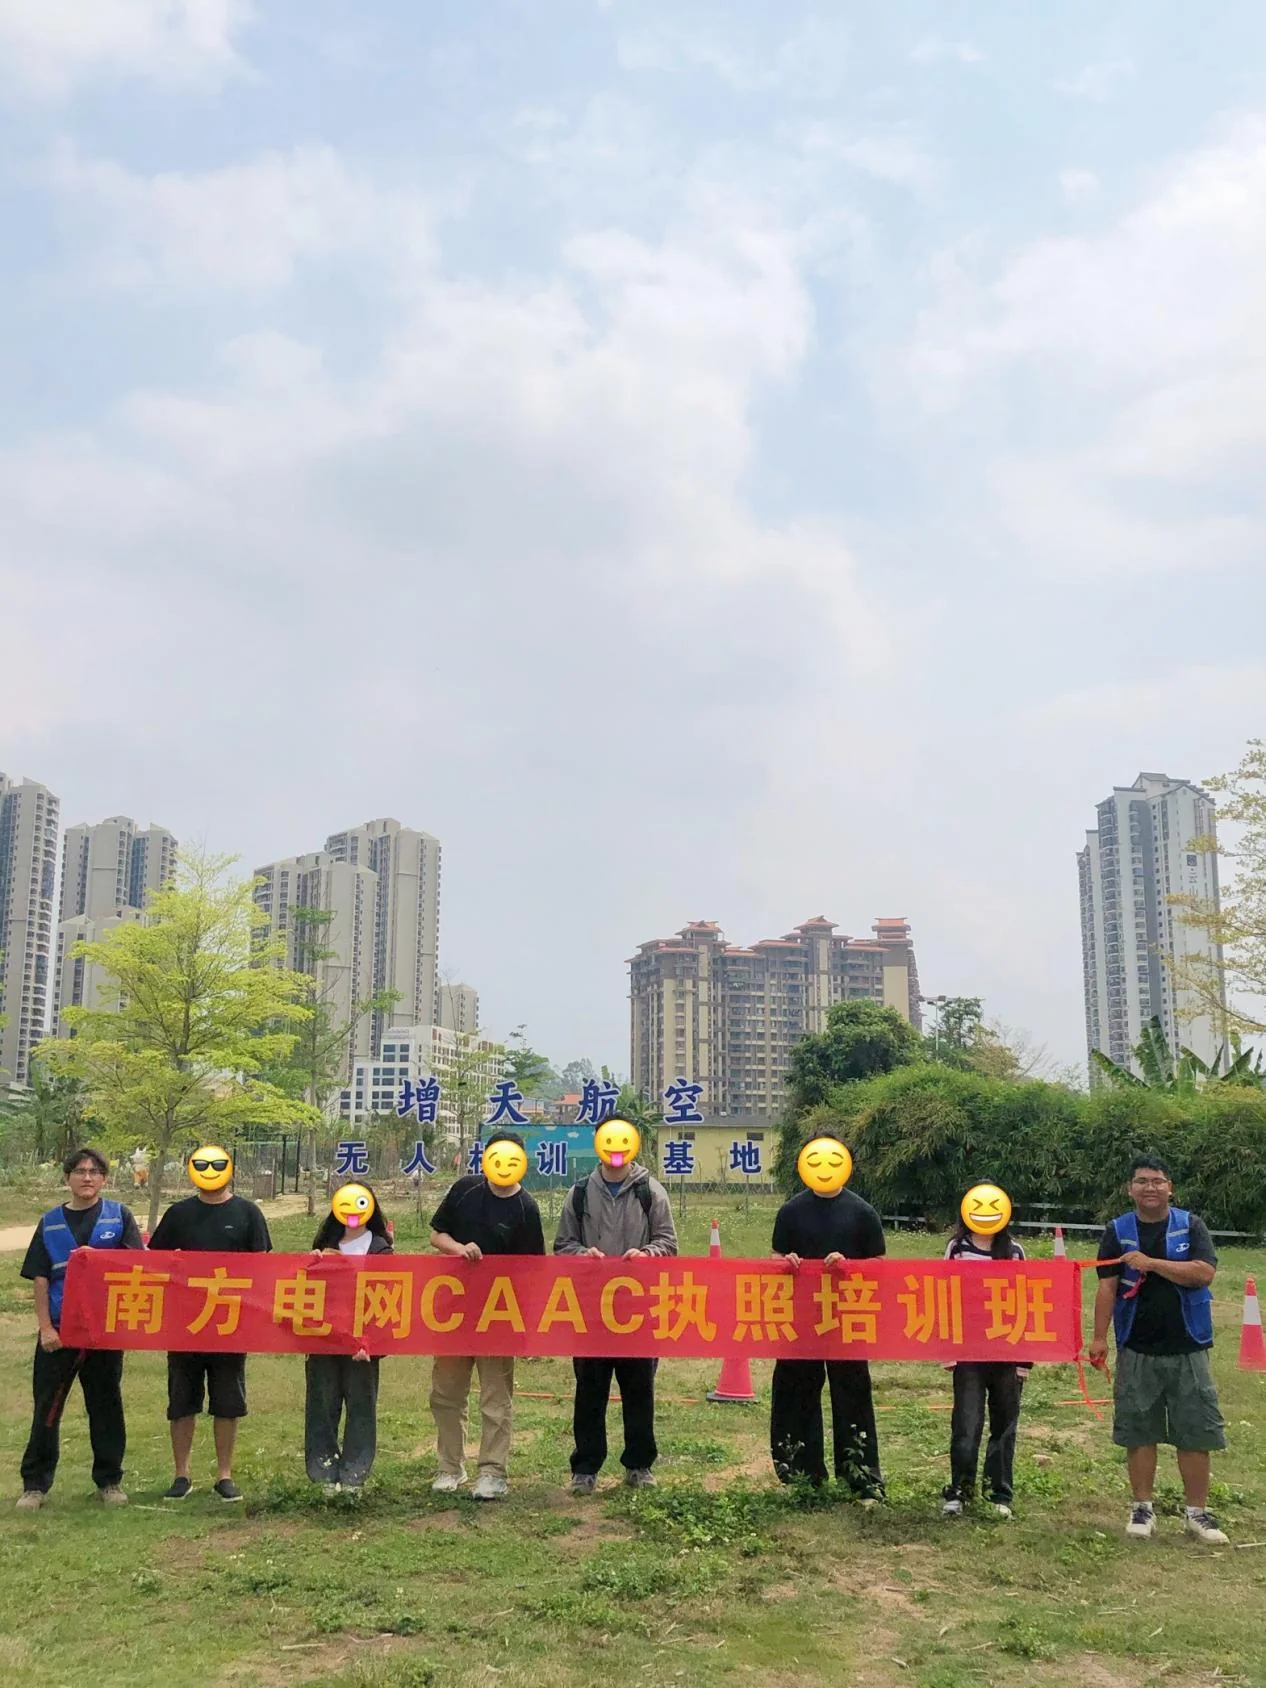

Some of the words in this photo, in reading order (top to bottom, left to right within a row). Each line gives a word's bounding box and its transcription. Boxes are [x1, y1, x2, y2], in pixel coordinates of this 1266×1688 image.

[397, 1076, 705, 1125] 增天航空
[103, 1265, 1058, 1346] 南方电网CAAC执照培训班
